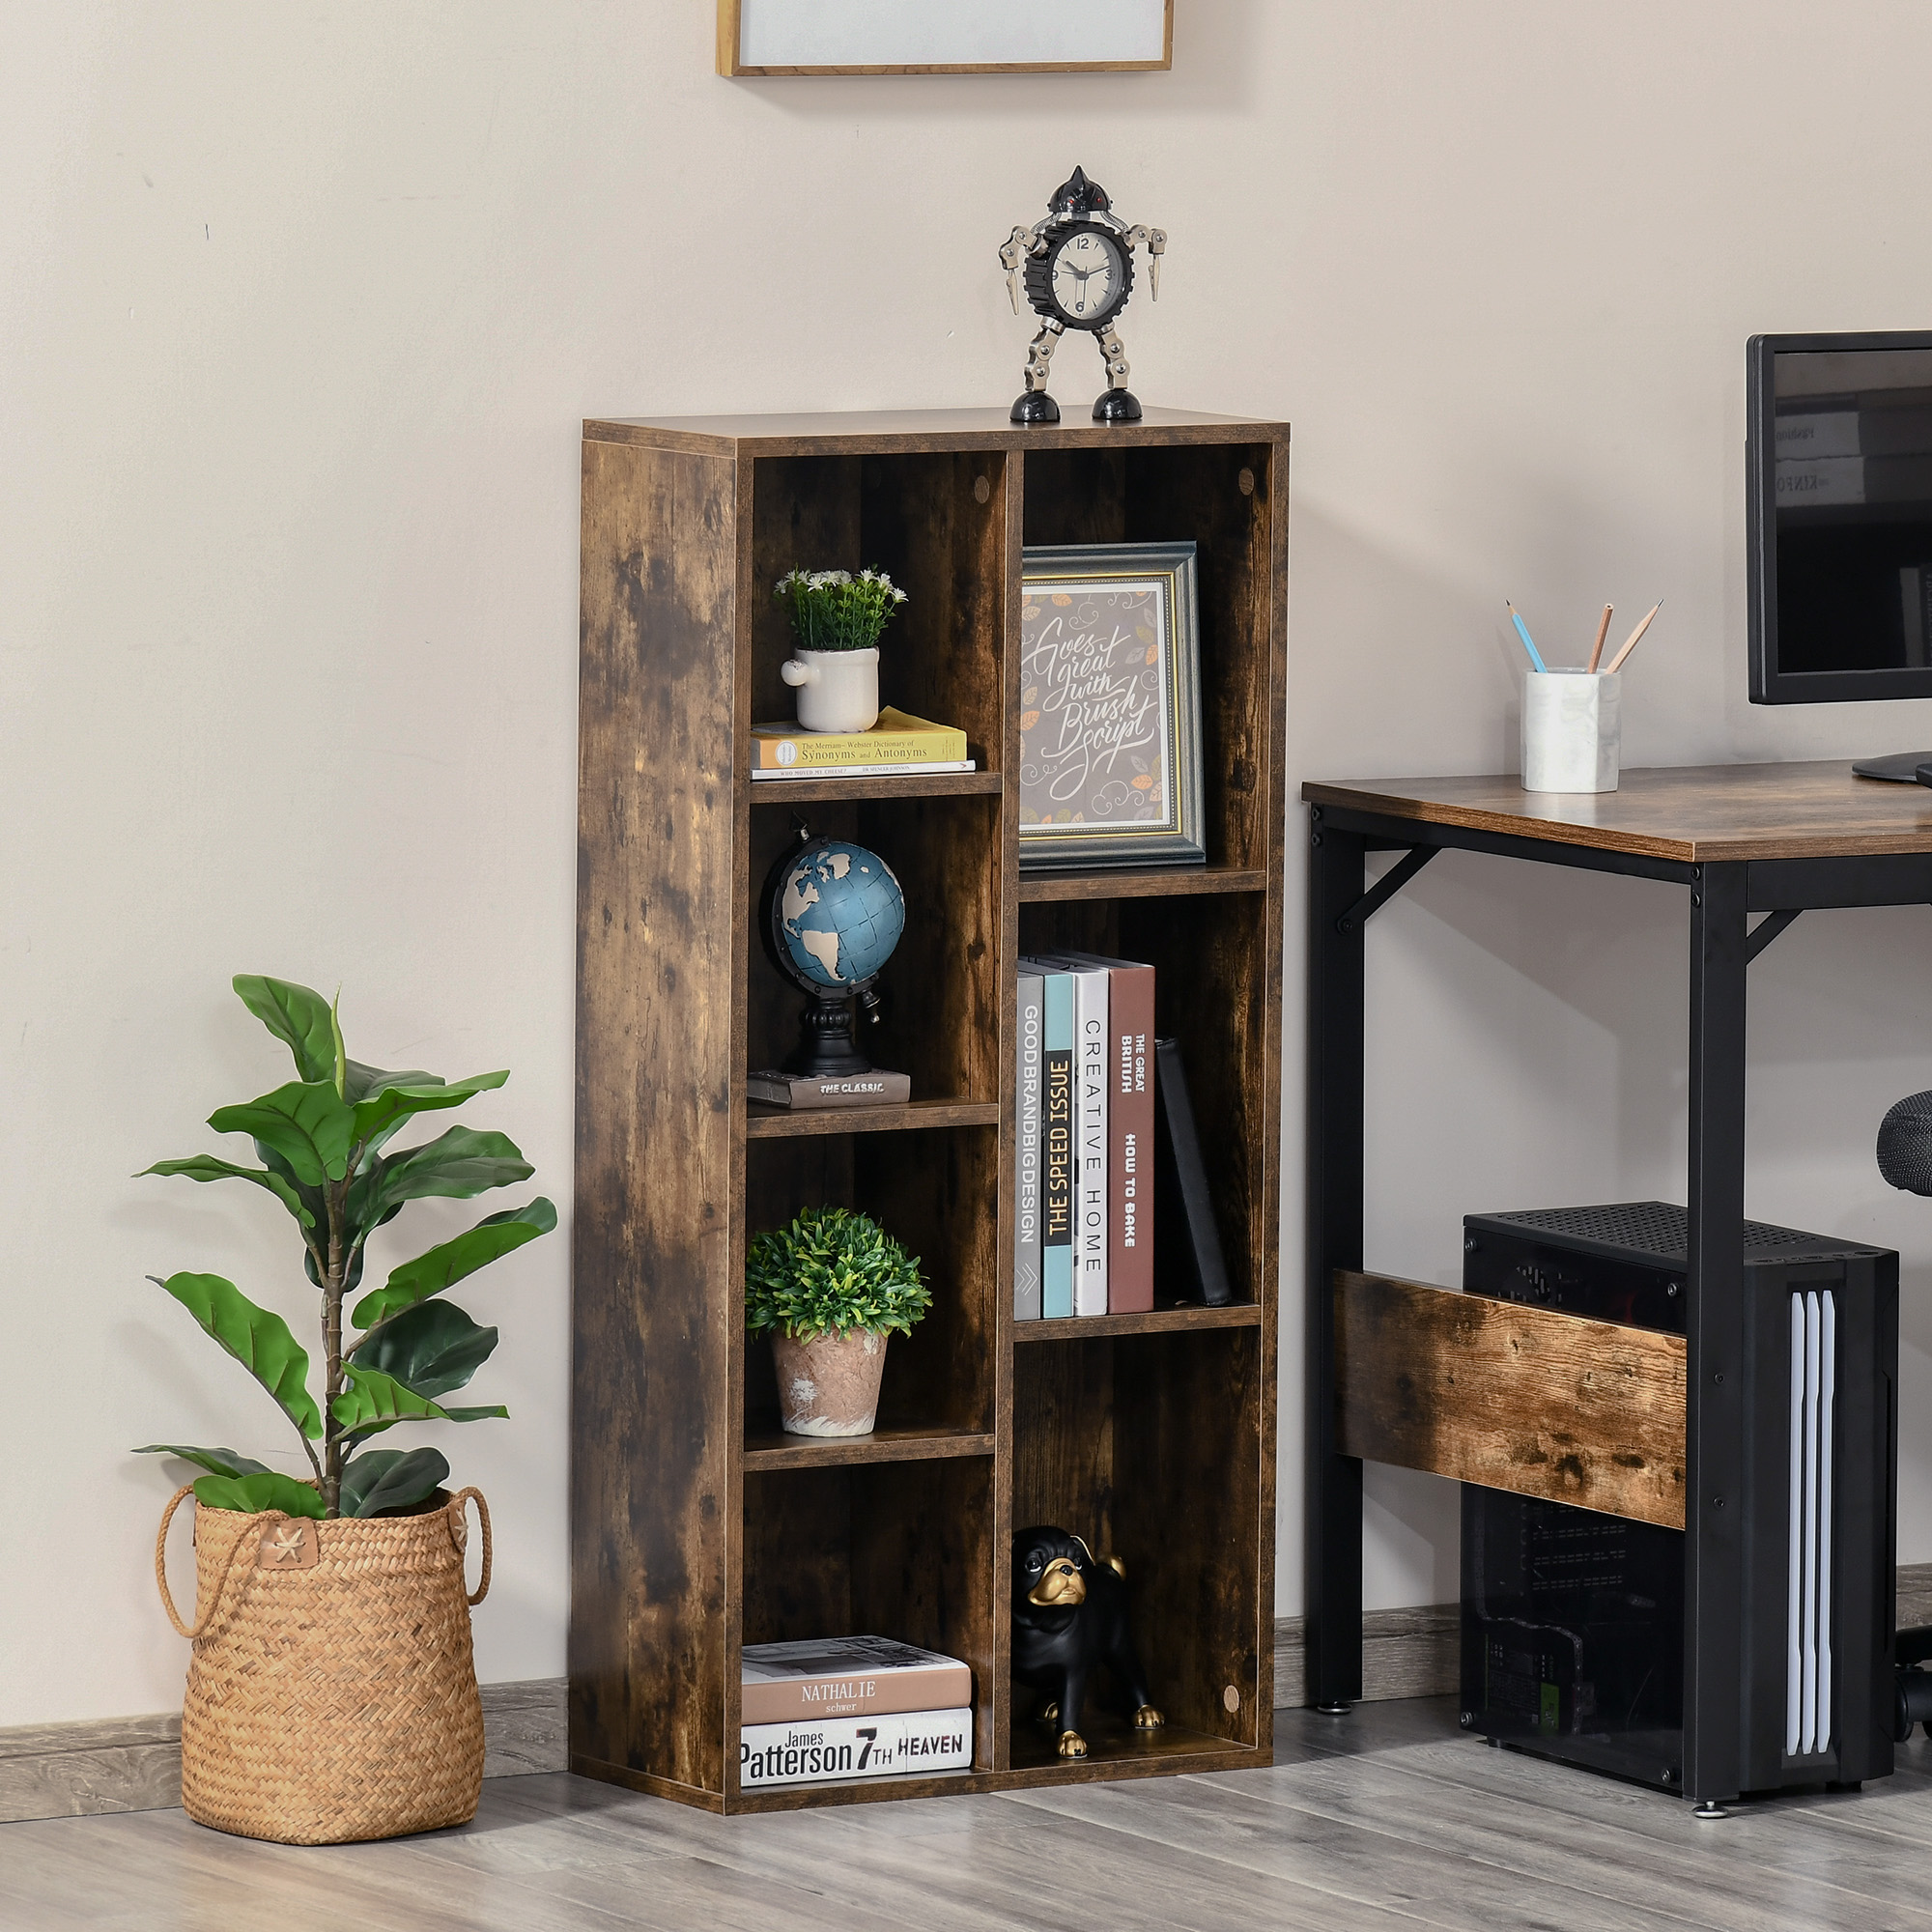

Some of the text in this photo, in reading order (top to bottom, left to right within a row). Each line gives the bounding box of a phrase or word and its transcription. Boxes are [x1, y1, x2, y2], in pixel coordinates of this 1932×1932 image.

[1077, 238, 1089, 249] 12
[1104, 270, 1113, 280] 3
[1075, 301, 1085, 312] 6
[1021, 616, 1107, 687] Goes
[1042, 625, 1131, 712] great
[1069, 671, 1131, 701] with
[1041, 674, 1139, 758] Brush
[802, 749, 856, 763] Synonyms
[874, 747, 927, 760] Antonyms
[873, 740, 906, 750] Dictionary
[1049, 695, 1158, 801] Script
[1023, 1005, 1038, 1063] GOOD
[1121, 1035, 1133, 1094] BRITISH
[1134, 1033, 1146, 1093] THE GREAT
[820, 1082, 885, 1094] THE CLASSIC
[1049, 1060, 1069, 1236] THE SPEED ISSUE
[1085, 1019, 1101, 1271] CREATIVE HOME
[1020, 1170, 1036, 1243] DESIGN
[1123, 1133, 1136, 1248] HOW TO BAKE
[801, 1681, 876, 1702] NATHALIE
[826, 1702, 858, 1713] schwer
[784, 1730, 824, 1747] James
[897, 1733, 963, 1756] HEAVEN
[741, 1743, 852, 1779] Patterson
